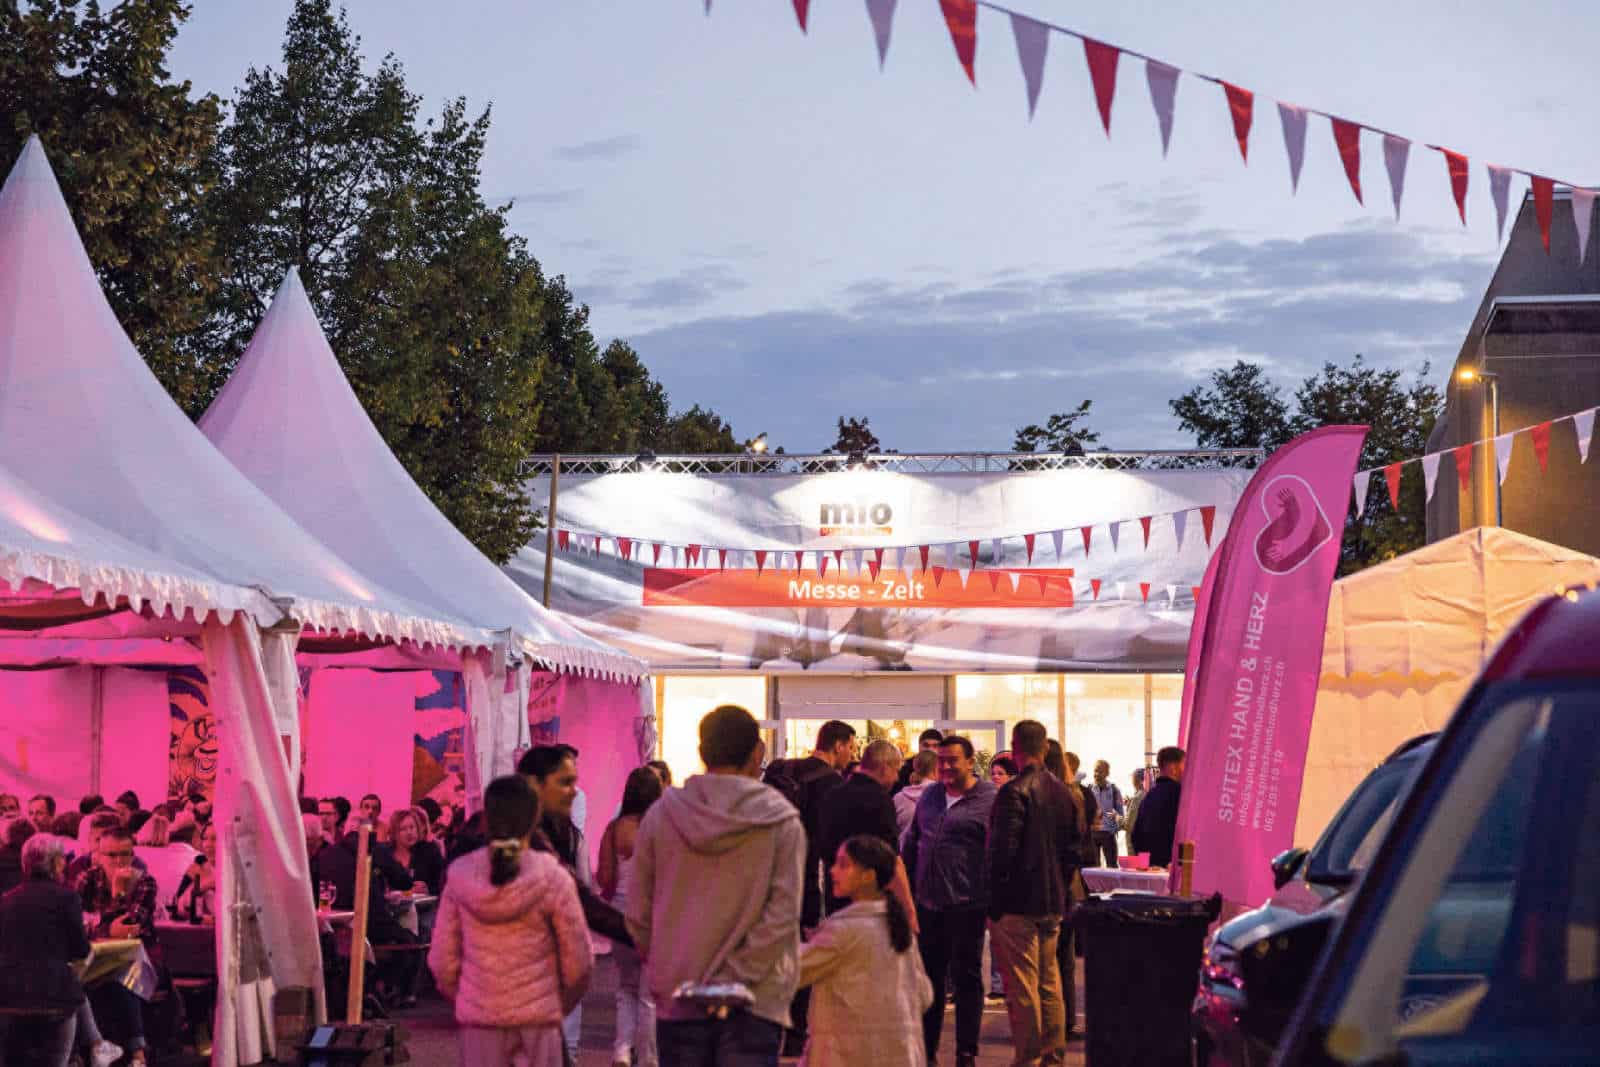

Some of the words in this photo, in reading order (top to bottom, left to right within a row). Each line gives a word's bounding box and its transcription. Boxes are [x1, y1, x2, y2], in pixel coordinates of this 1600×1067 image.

[819, 503, 893, 525] mio
[788, 580, 861, 600] Messe
[881, 580, 925, 600] Zelt
[1243, 591, 1269, 650] HERZ
[1240, 658, 1257, 672] &
[1230, 676, 1254, 740] HAND
[1218, 745, 1244, 823] SPITEX
